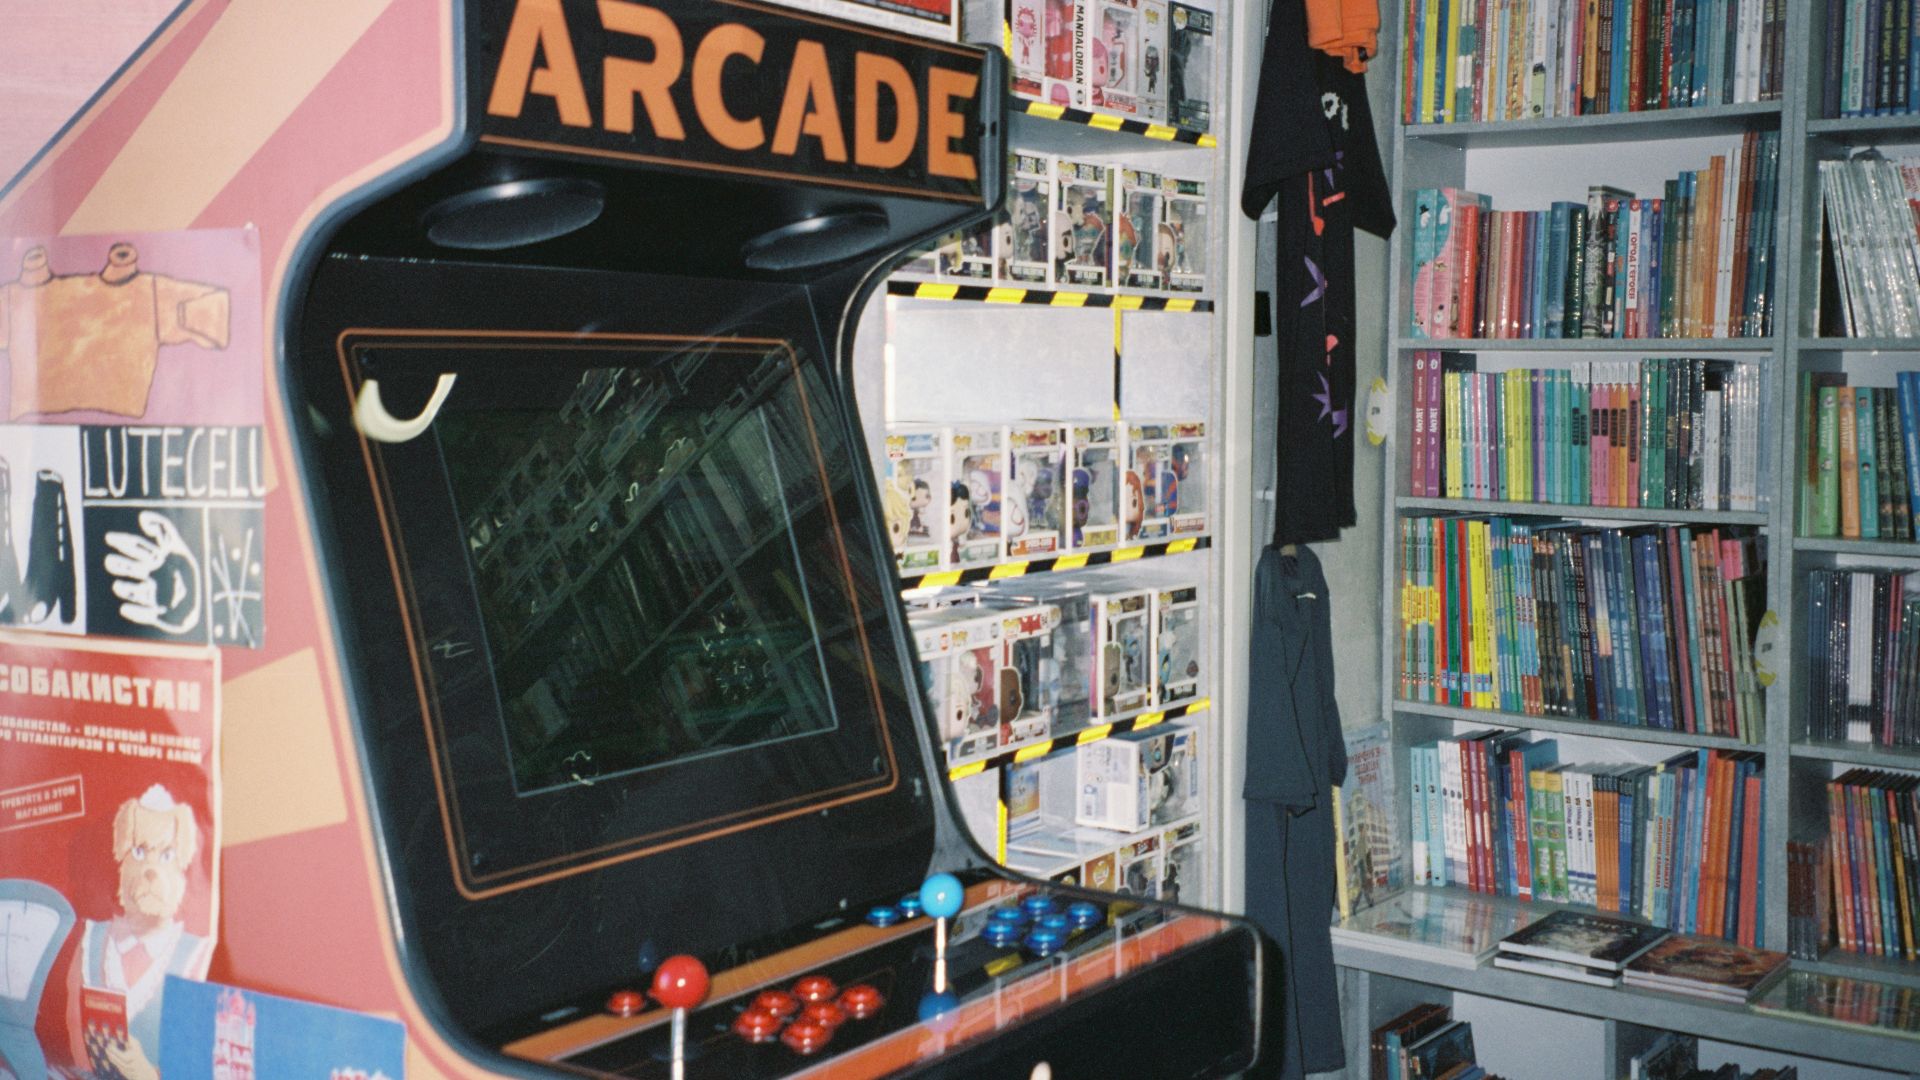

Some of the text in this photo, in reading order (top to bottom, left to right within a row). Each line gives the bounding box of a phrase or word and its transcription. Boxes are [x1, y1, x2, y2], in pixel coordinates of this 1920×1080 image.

[1075, 5, 1085, 85] MANDALORIAN
[487, 0, 979, 180] ARCADE
[52, 784, 76, 799] ЭТОМ
